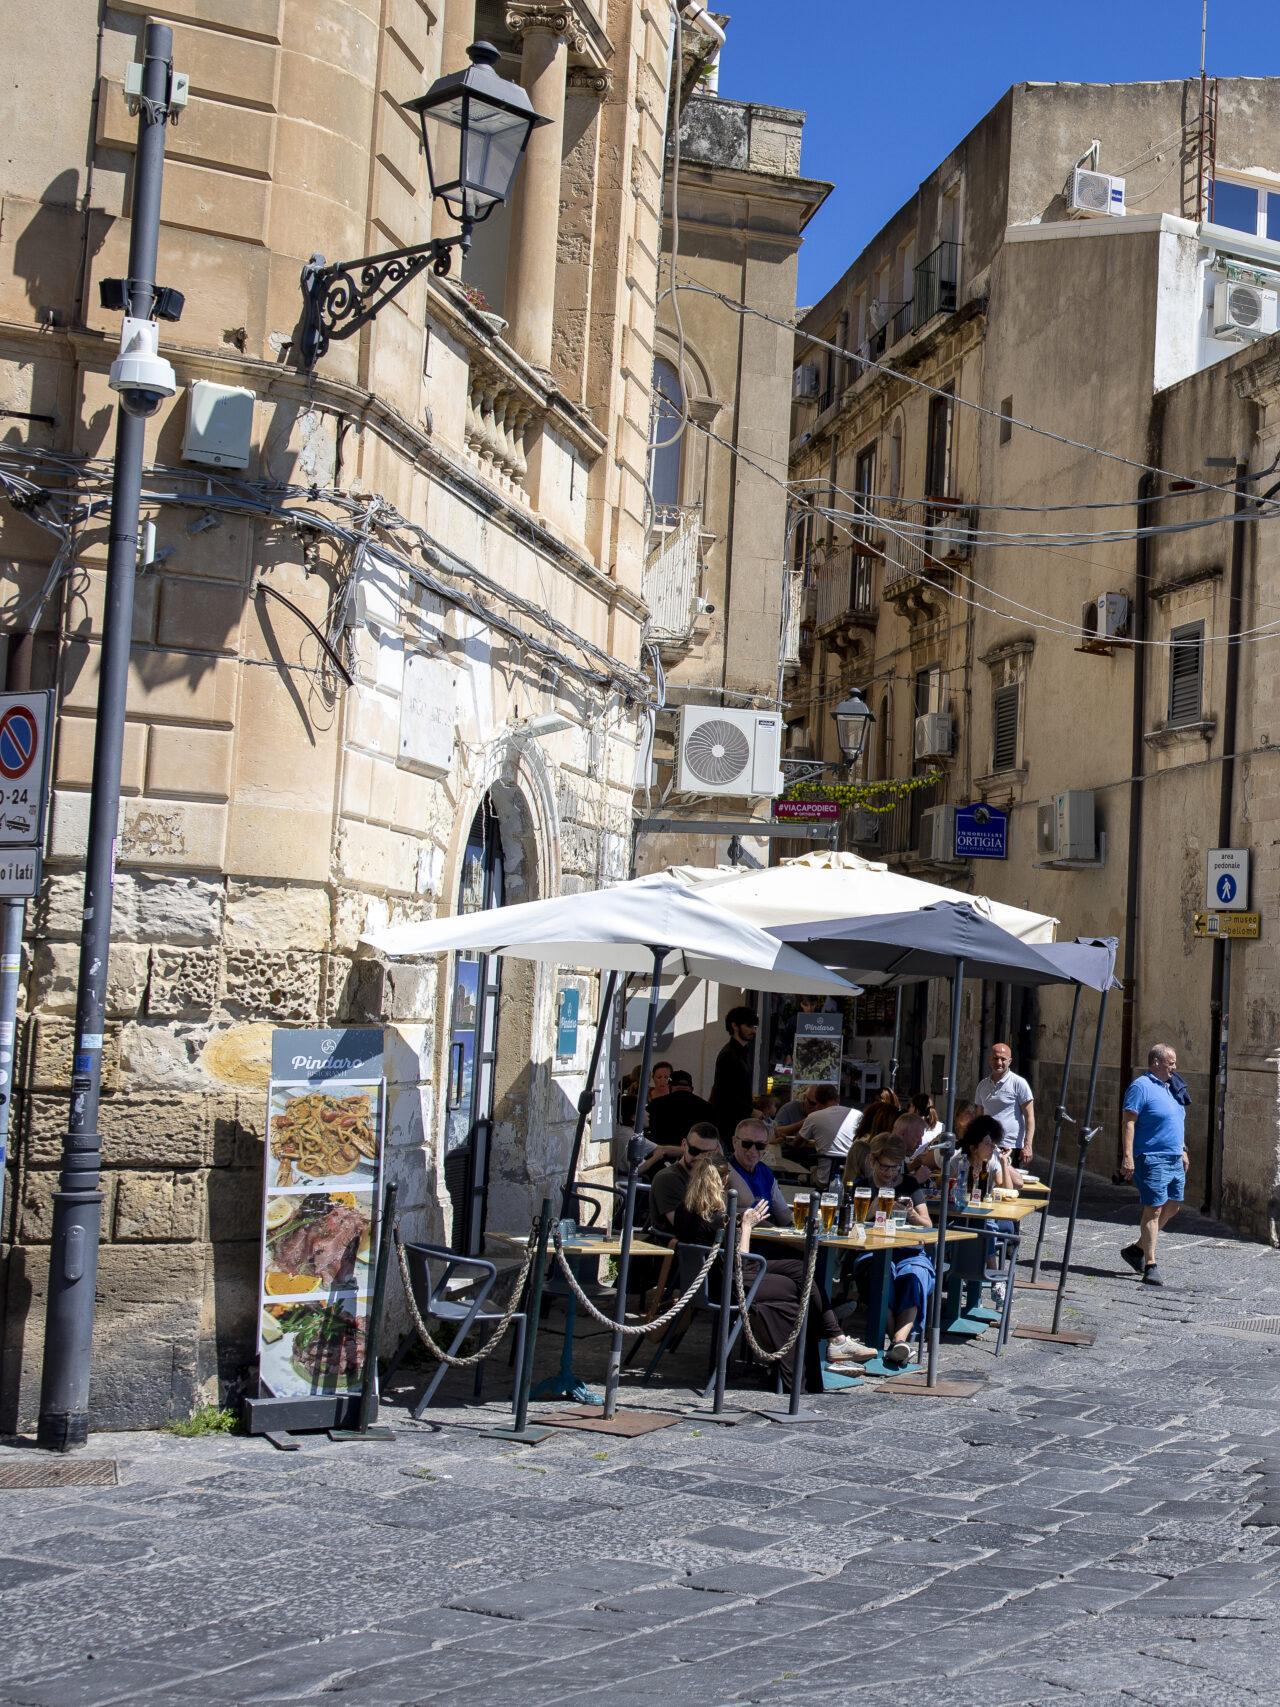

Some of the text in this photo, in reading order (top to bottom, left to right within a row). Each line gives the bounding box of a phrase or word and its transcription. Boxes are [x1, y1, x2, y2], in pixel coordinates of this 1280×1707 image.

[778, 804, 837, 812] #VIACAPODIECI
[957, 835, 1003, 848] ORTIGIA
[1214, 861, 1240, 870] pedonale
[15, 863, 34, 880] lati
[1233, 916, 1257, 924] museo
[291, 1055, 365, 1070] Pindaro
